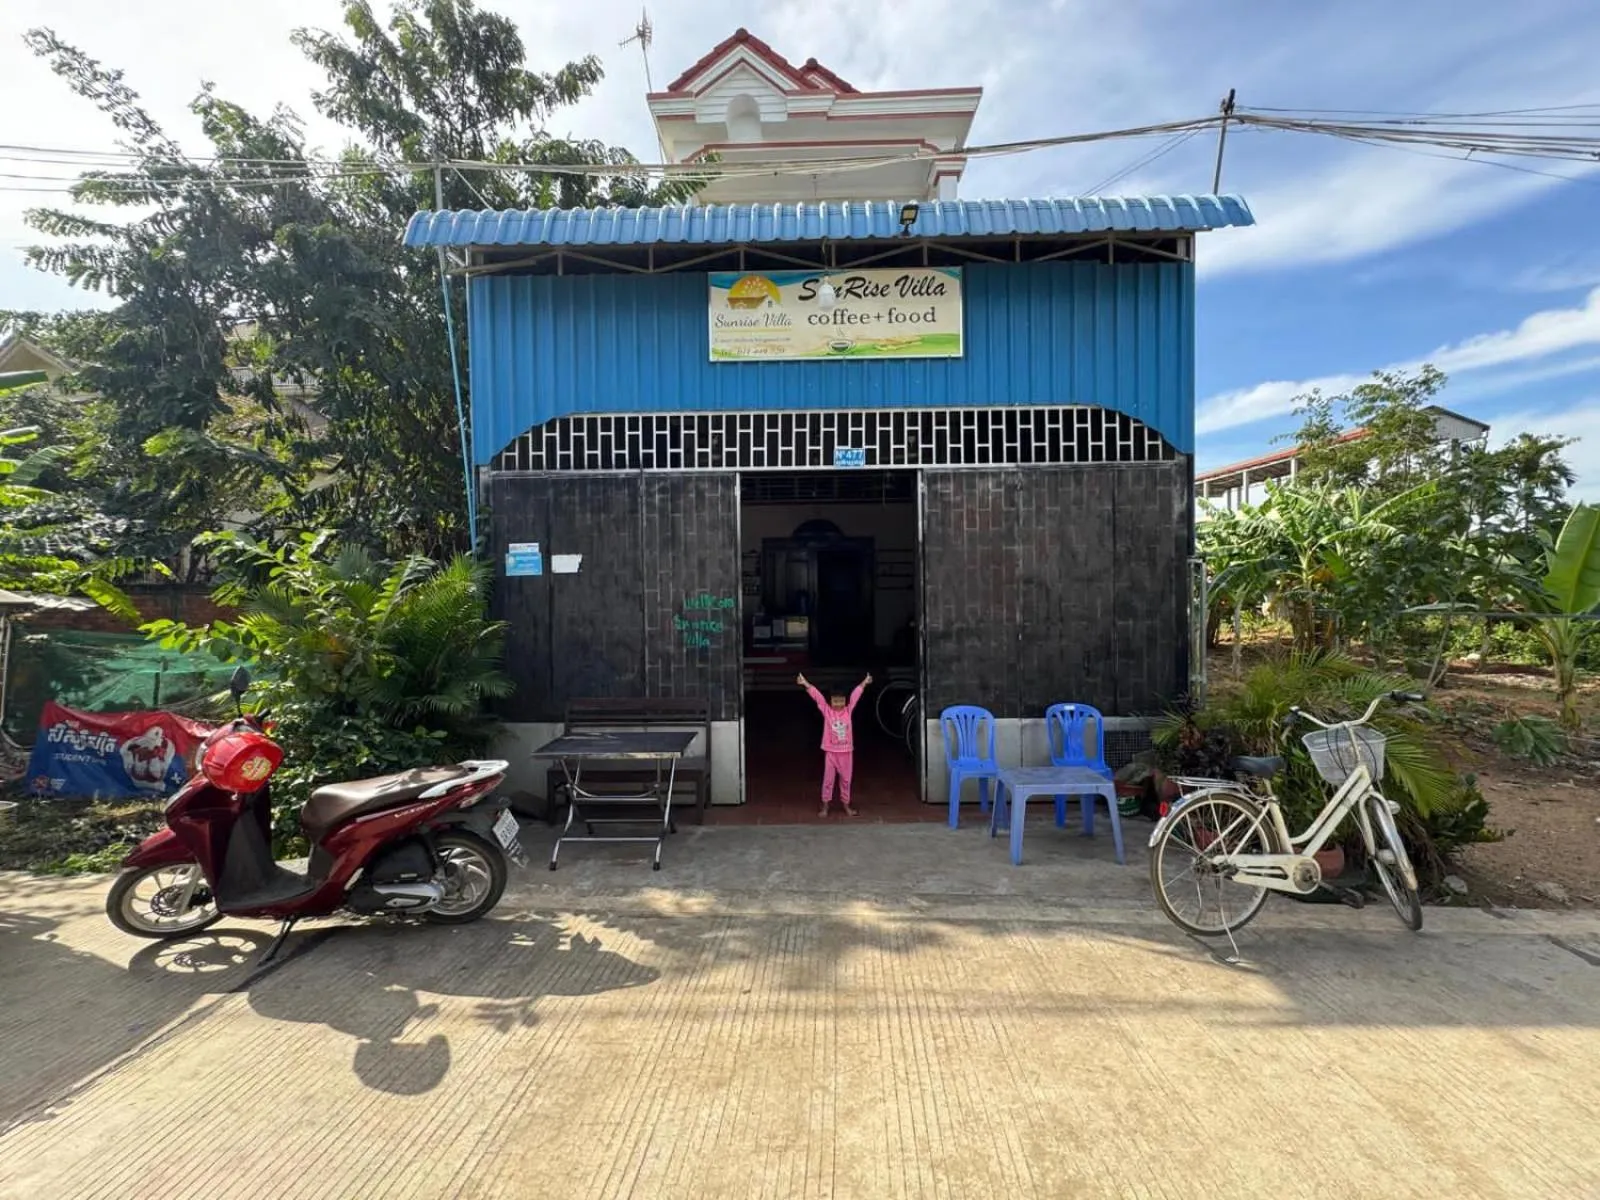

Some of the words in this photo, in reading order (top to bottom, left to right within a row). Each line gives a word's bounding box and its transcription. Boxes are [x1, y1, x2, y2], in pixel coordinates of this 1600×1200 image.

[798, 275, 891, 301] SnRise
[894, 273, 948, 299] Villa
[714, 311, 760, 328] Sunrise
[763, 310, 792, 327] Villa
[807, 306, 937, 326] coffee+food
